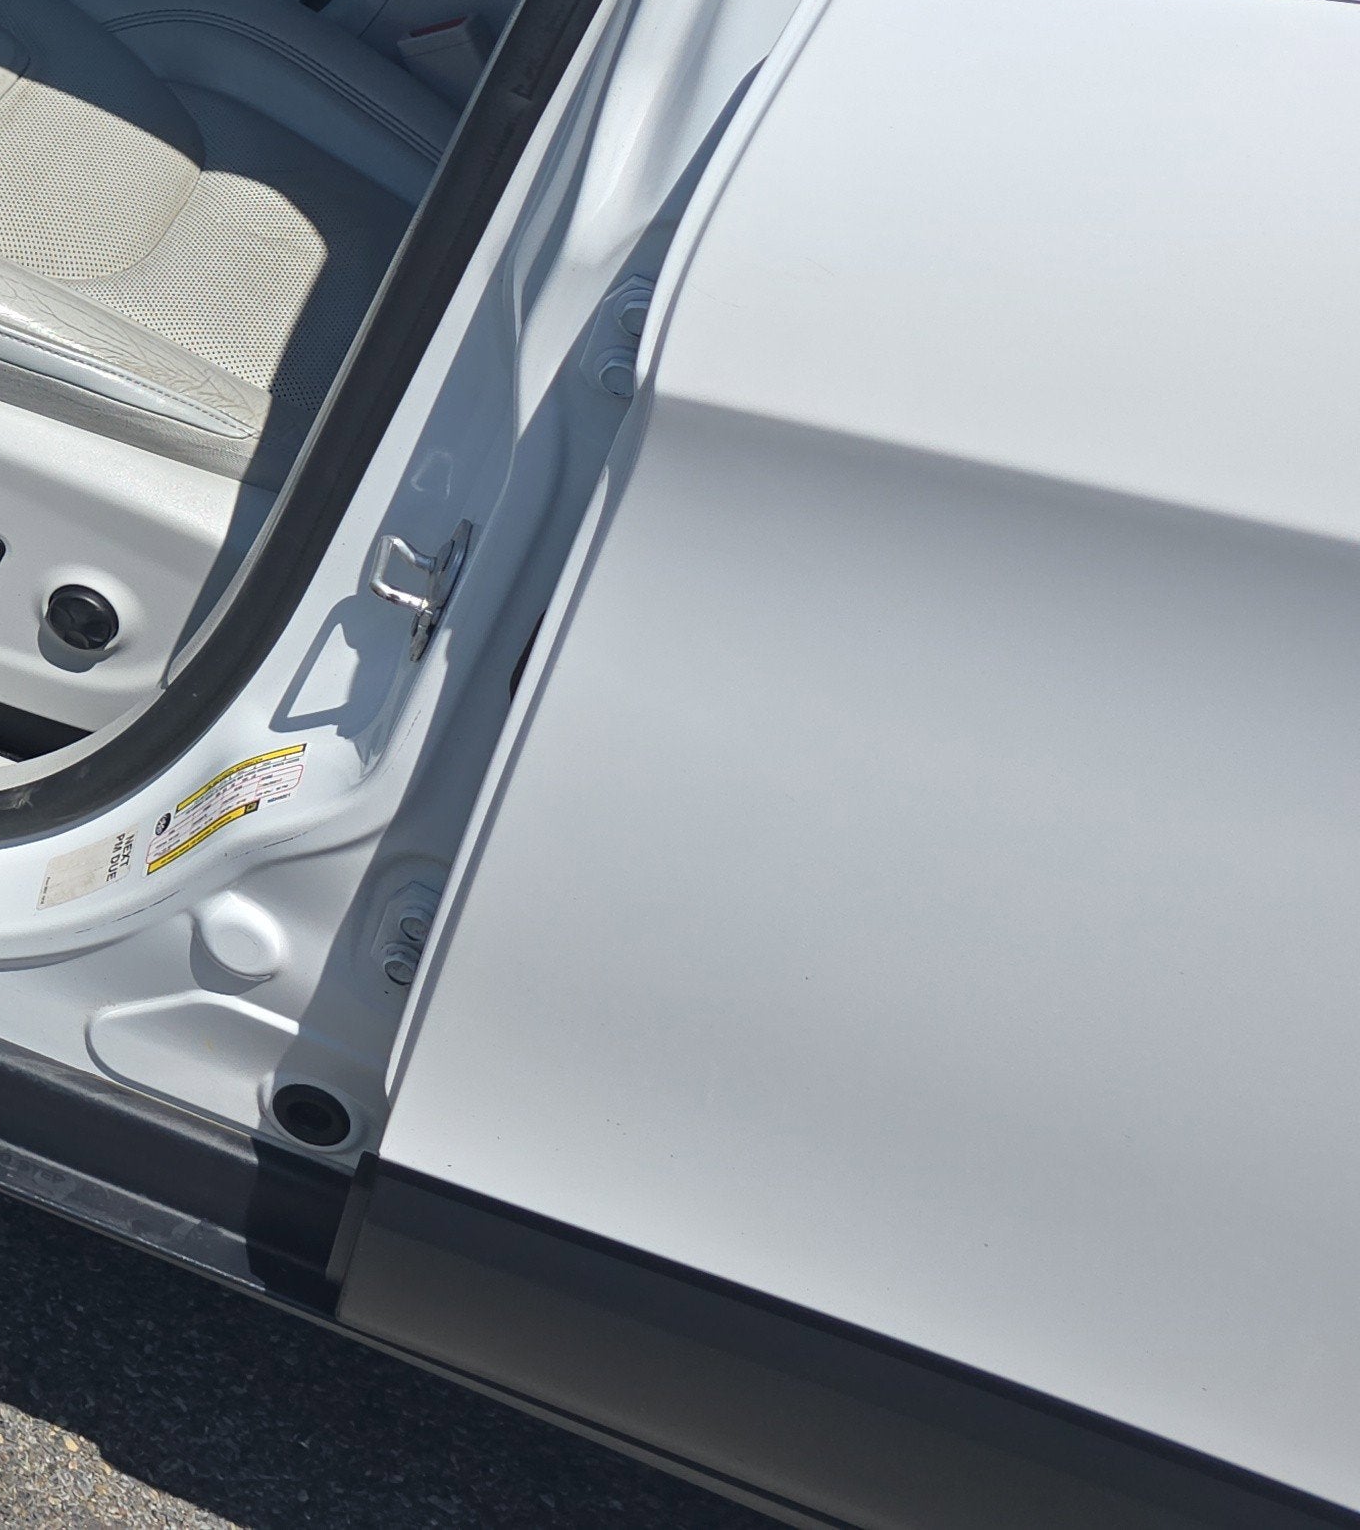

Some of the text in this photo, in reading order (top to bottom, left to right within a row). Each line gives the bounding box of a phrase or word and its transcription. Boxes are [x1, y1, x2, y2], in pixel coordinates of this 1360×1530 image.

[105, 832, 126, 882] PM DUE
[119, 833, 135, 868] NEXT
